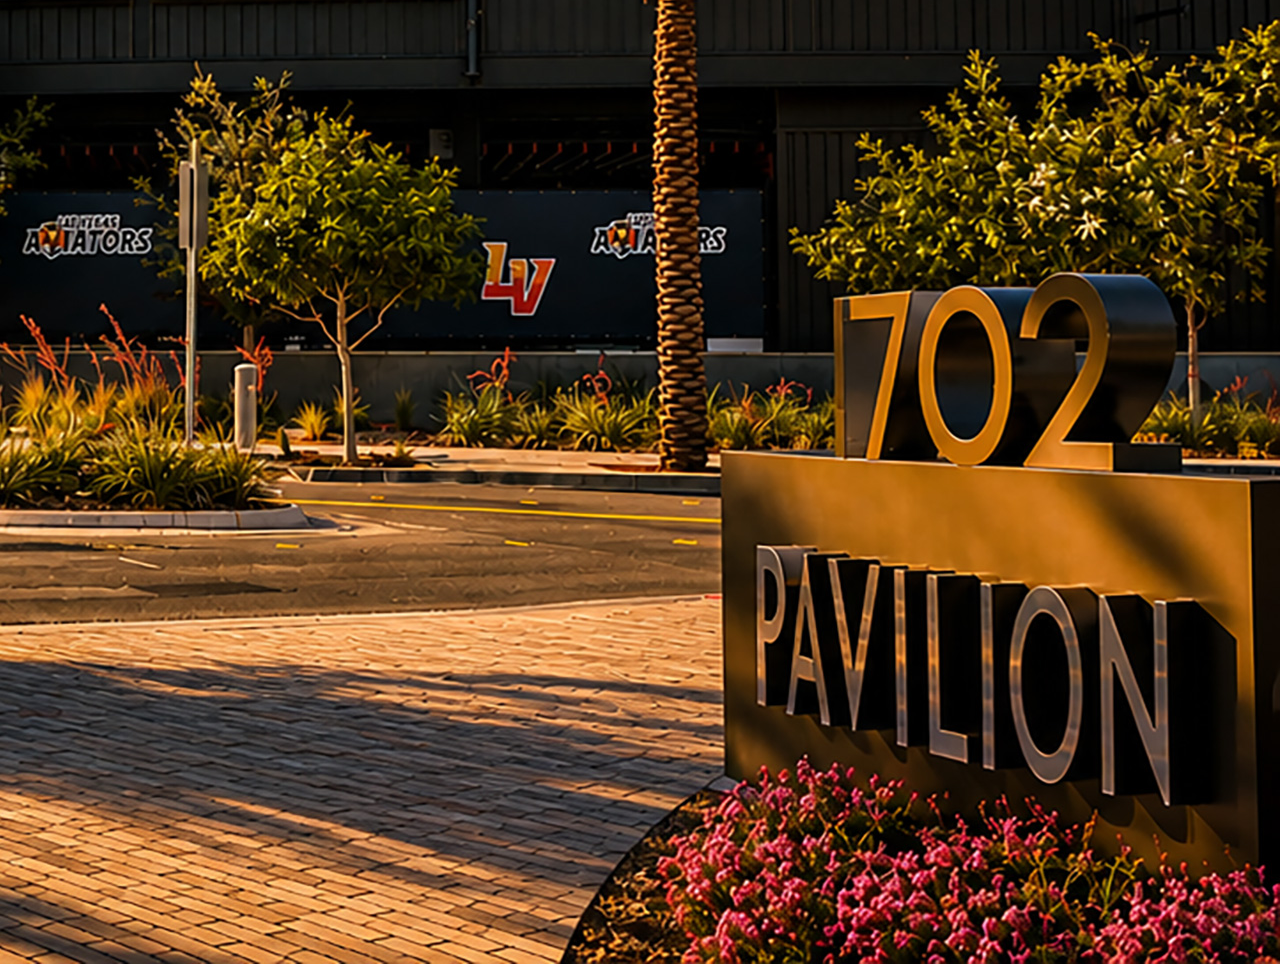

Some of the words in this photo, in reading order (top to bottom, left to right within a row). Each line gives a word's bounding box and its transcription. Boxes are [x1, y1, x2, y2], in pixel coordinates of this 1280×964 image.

[481, 241, 556, 316] LV
[847, 273, 1114, 471] 702
[756, 544, 1171, 807] PAVILION
